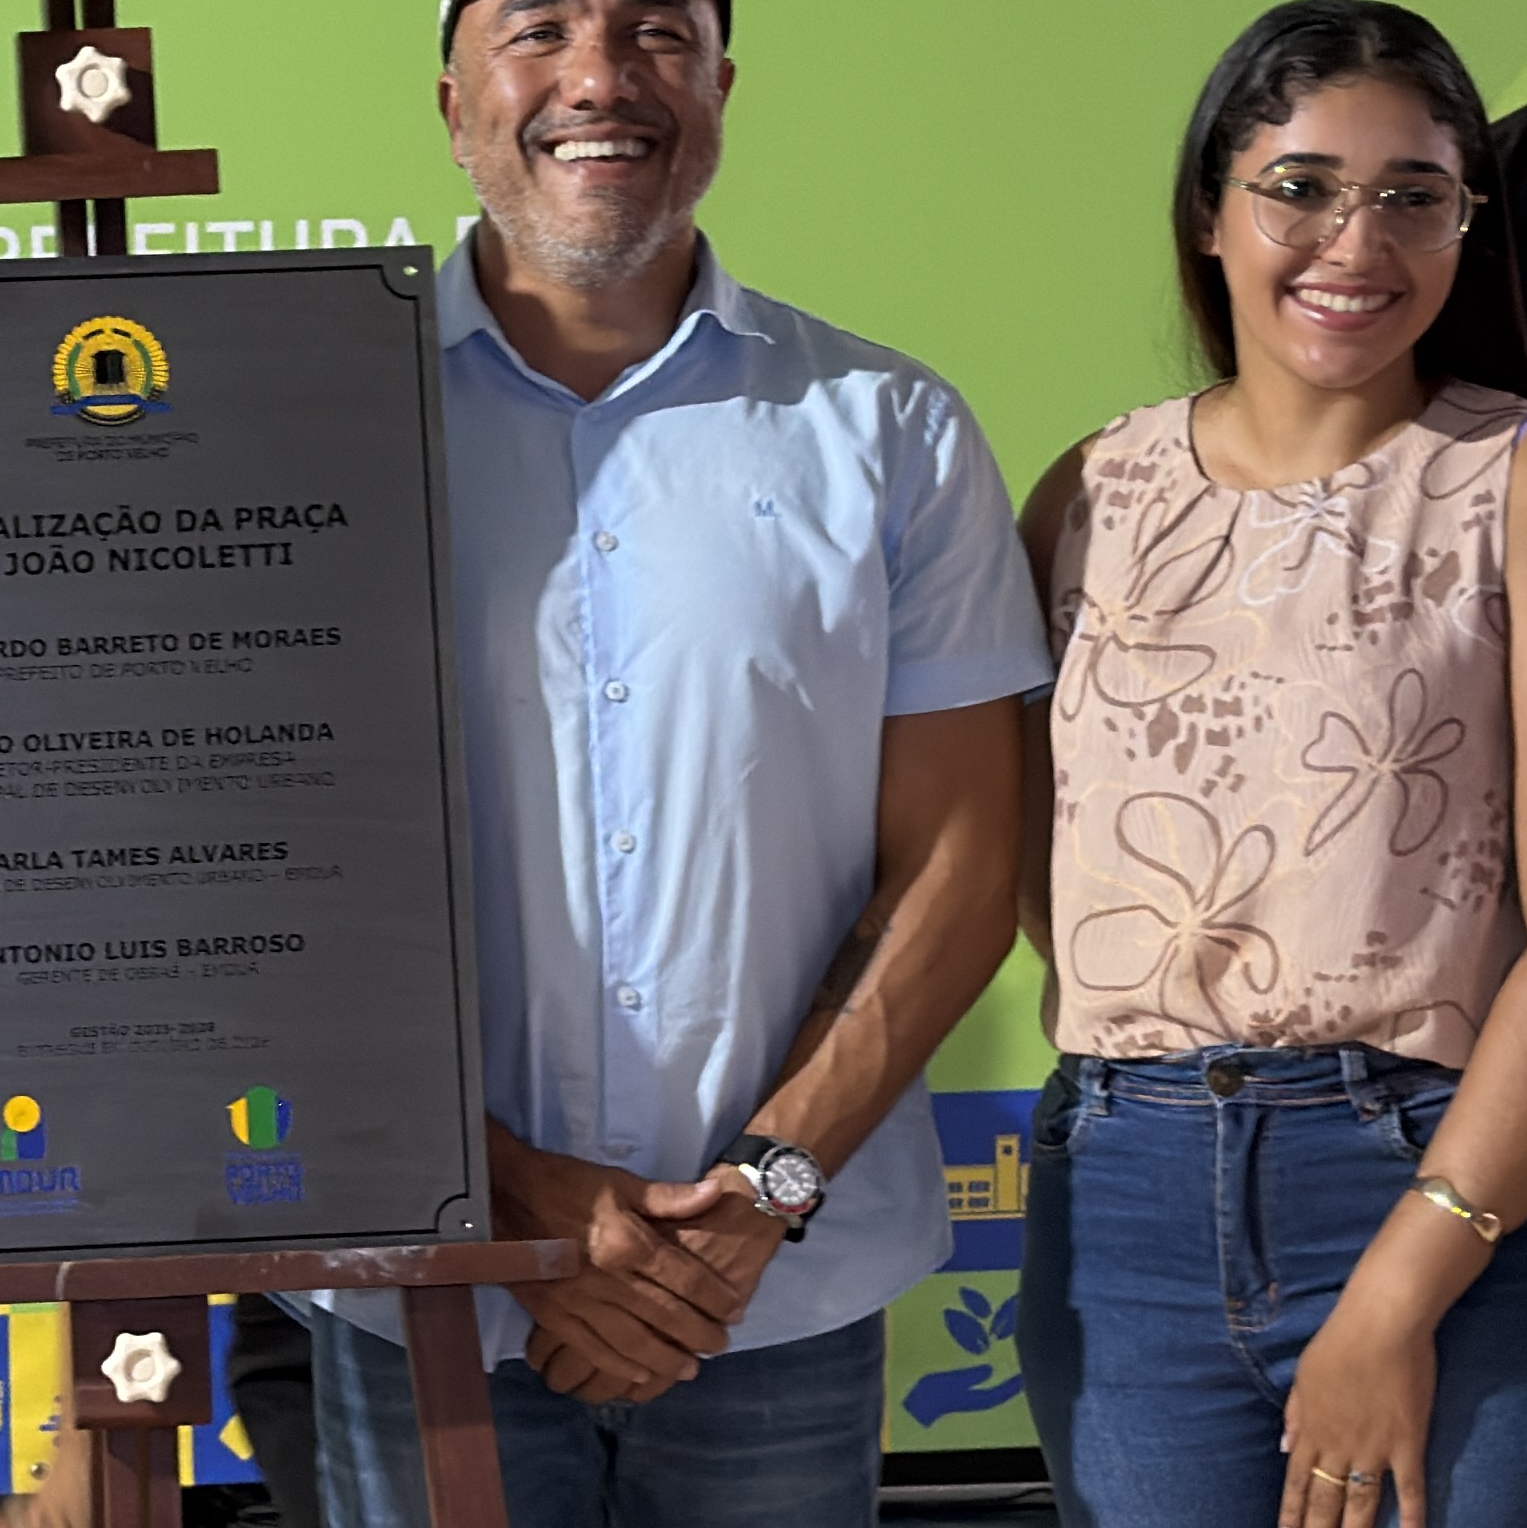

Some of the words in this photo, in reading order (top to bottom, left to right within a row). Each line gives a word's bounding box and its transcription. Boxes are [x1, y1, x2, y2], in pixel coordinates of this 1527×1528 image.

[176, 509, 223, 533] DA
[235, 502, 349, 534] PRAÇA
[3, 544, 95, 577] JOÃO
[108, 541, 293, 572] NICOLETTI
[57, 633, 179, 657] BARRETO
[188, 631, 223, 651] DE
[231, 626, 342, 650] MORAES
[23, 730, 153, 754] OLIVEIRA
[161, 728, 195, 748] DE
[204, 722, 335, 746] HOLANDA
[71, 846, 160, 870] TAMES
[169, 841, 289, 865] ALVARES
[104, 939, 168, 961] LUIS
[176, 933, 306, 958] BARROSO
